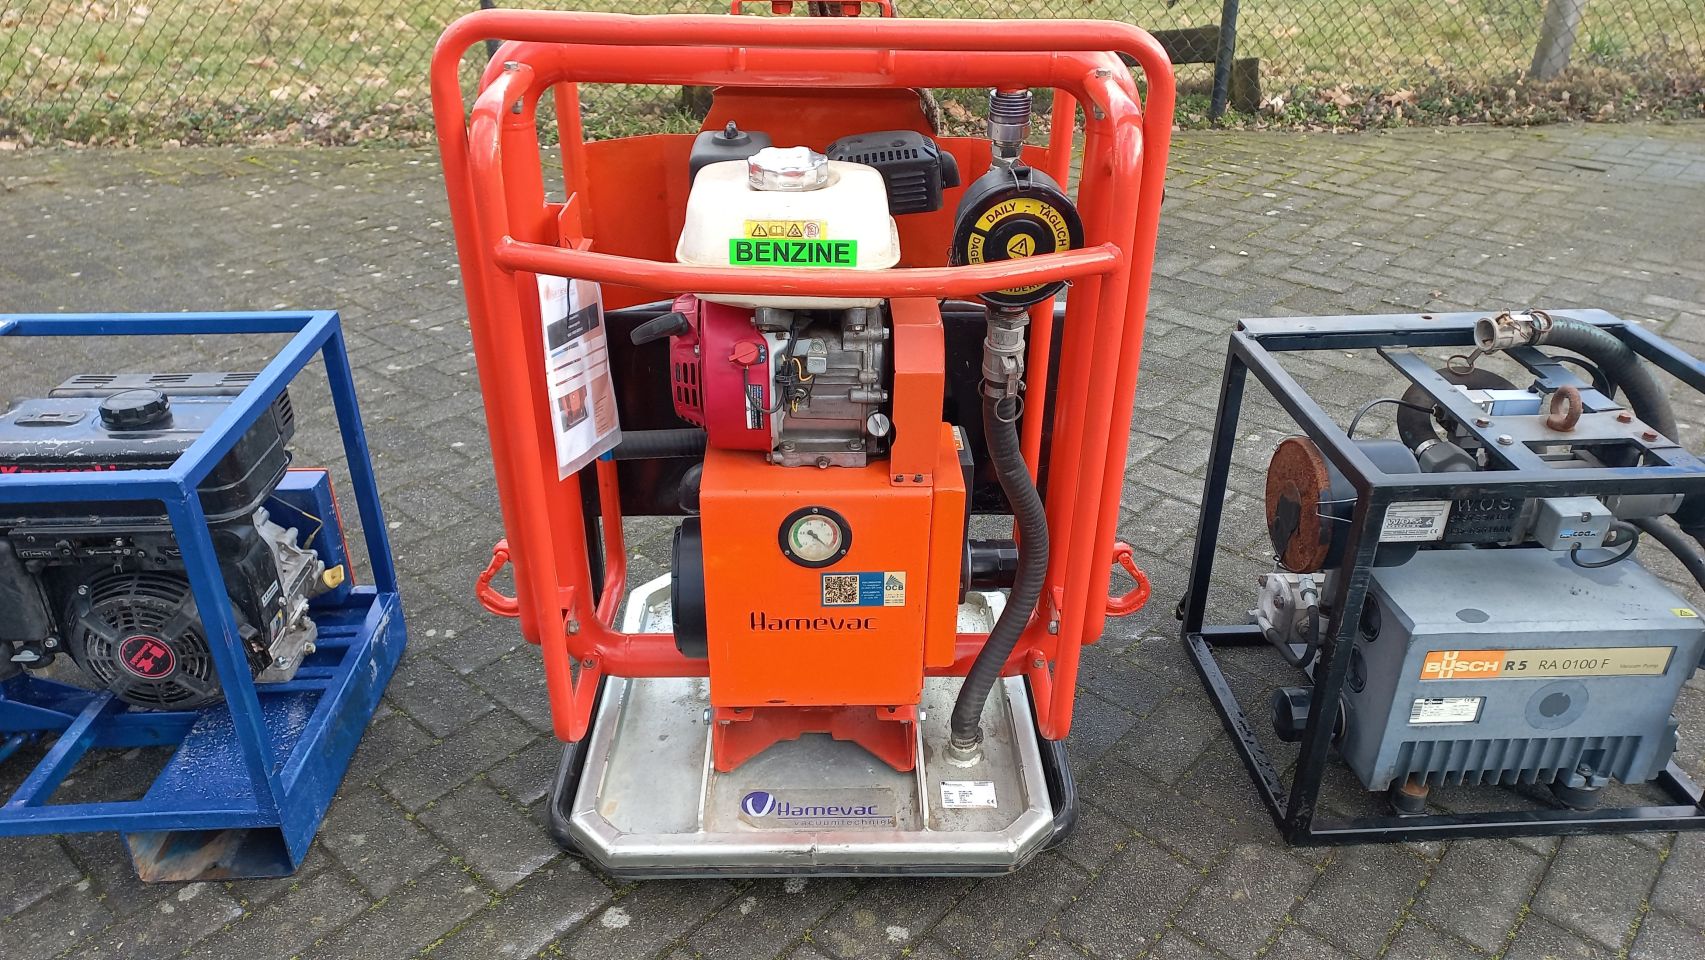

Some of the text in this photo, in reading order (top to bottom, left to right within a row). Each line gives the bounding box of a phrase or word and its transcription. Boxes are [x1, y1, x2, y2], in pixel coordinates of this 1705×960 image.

[986, 202, 1016, 223] DAILY
[736, 241, 850, 263] BENZINE
[970, 236, 982, 263] DAGE
[750, 612, 878, 631] Hamevac
[1425, 660, 1499, 673] BUSCH
[1505, 661, 1515, 671] R
[1518, 661, 1528, 671] 5
[1538, 660, 1558, 670] RA
[1562, 659, 1597, 670] 0100
[1601, 659, 1611, 669] F
[778, 802, 879, 816] Hamevac
